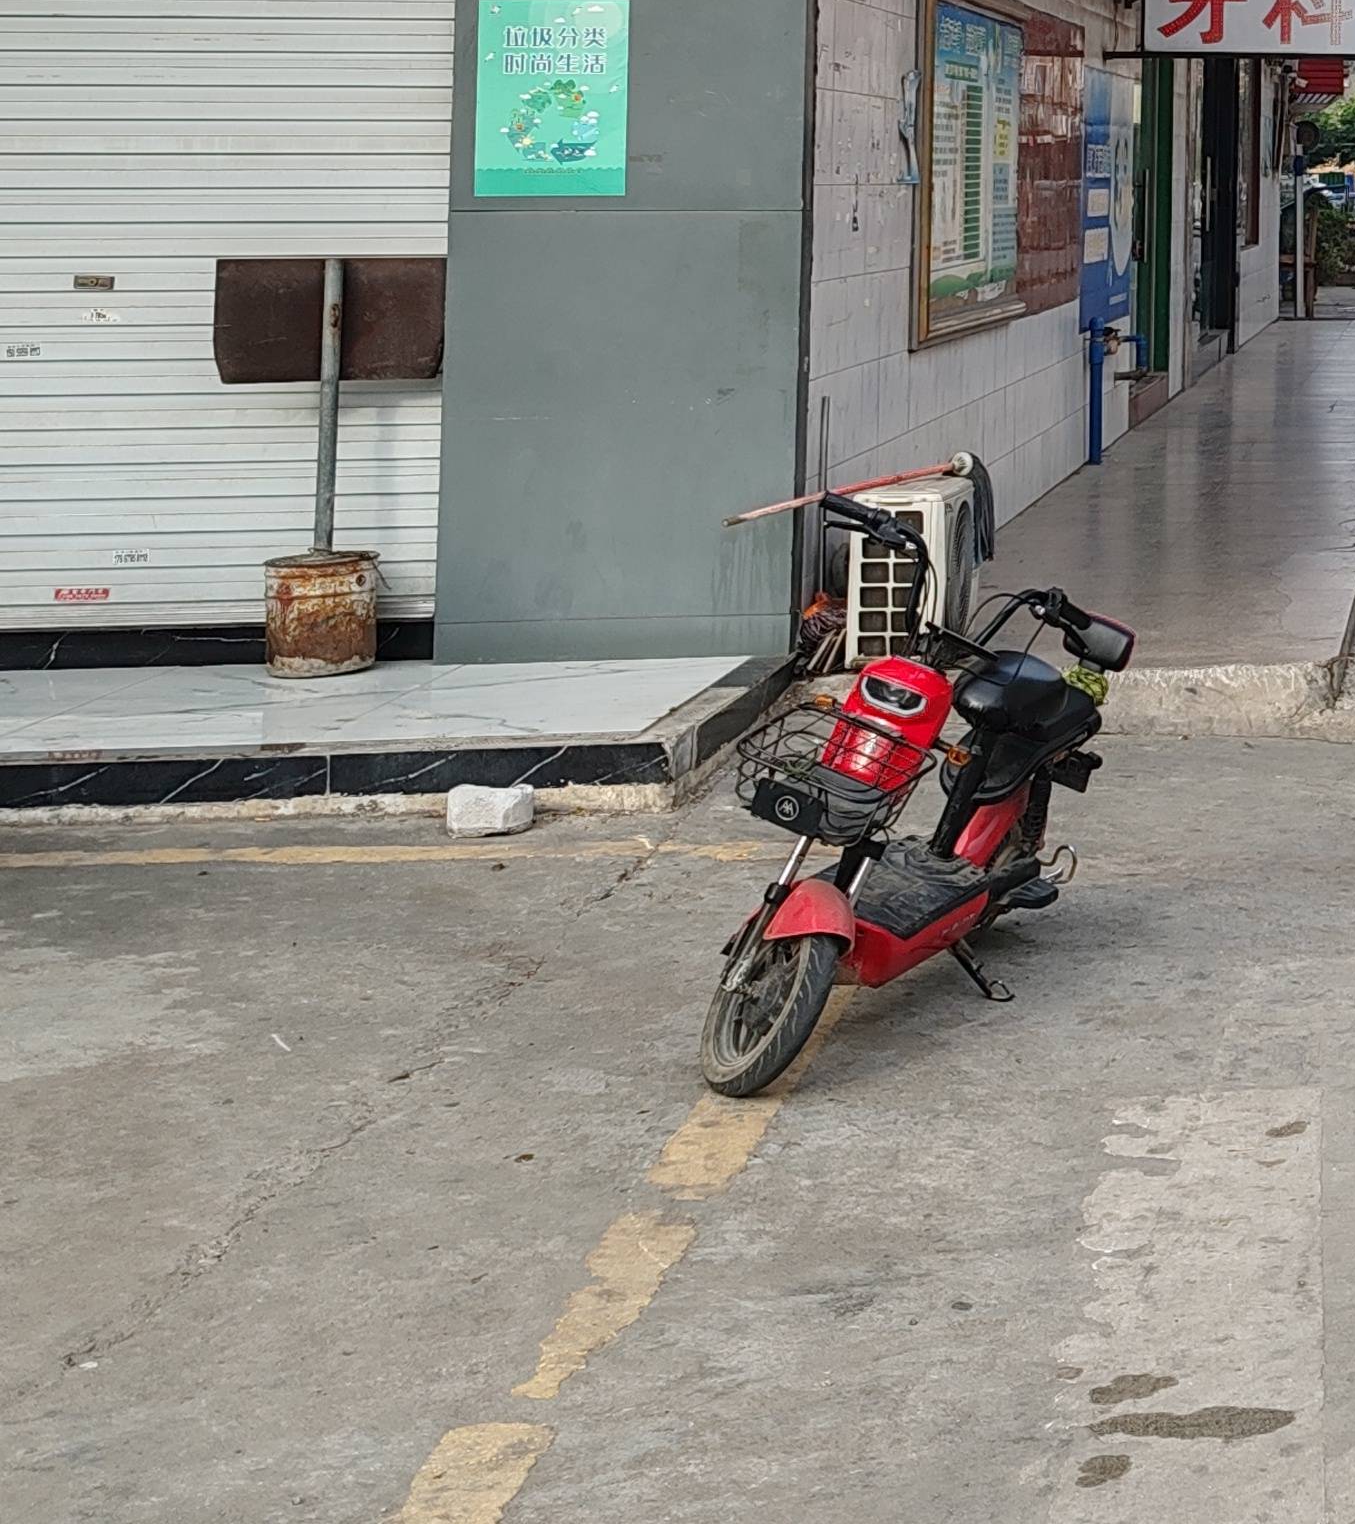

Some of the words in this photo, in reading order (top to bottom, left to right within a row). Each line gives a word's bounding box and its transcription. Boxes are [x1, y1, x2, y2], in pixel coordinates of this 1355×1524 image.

[503, 26, 607, 48] 垃圾分类
[503, 53, 606, 74] 时尚生活
